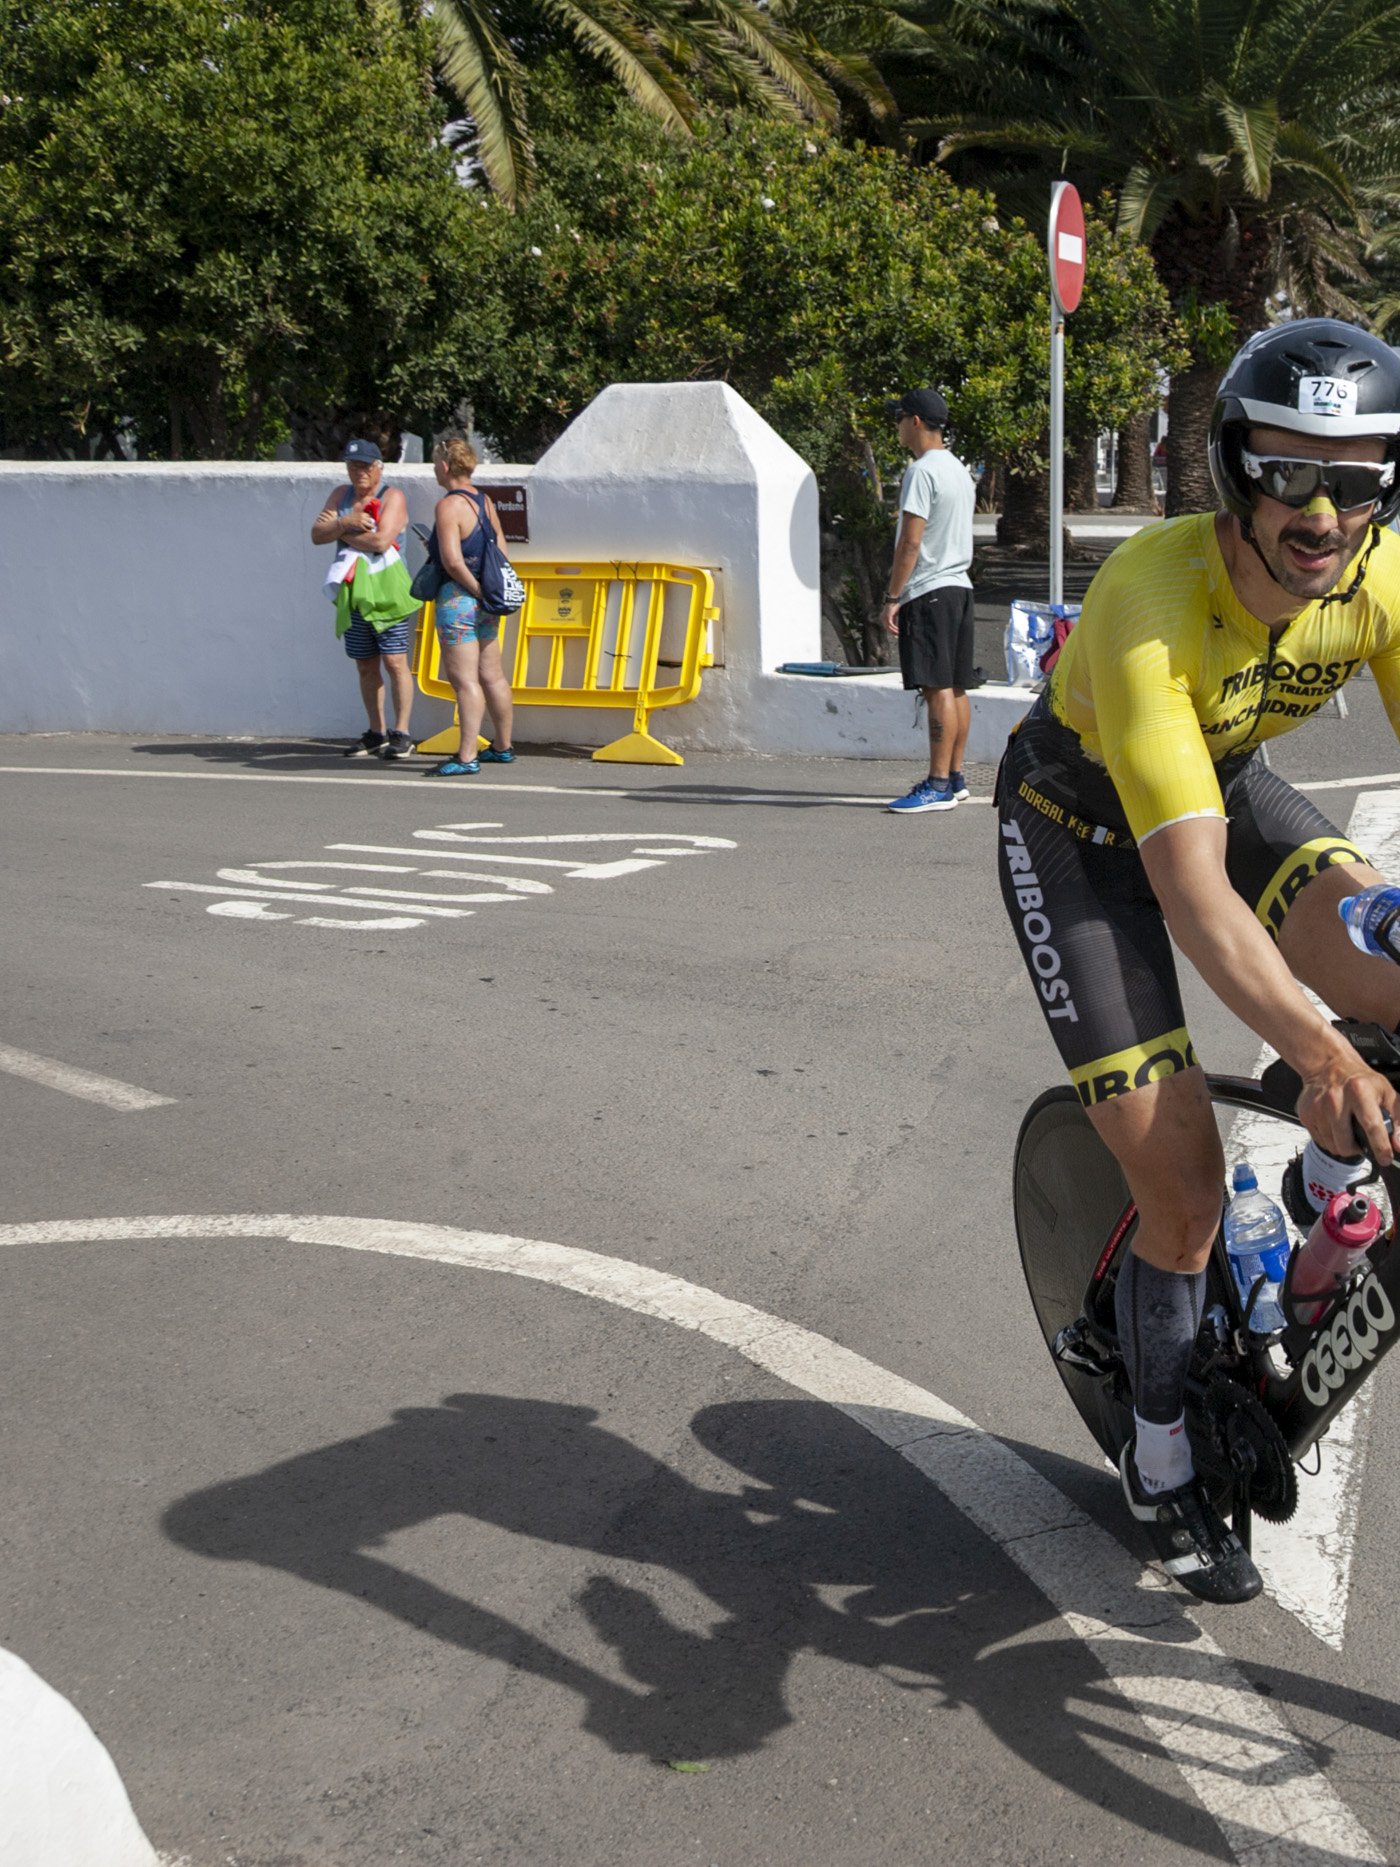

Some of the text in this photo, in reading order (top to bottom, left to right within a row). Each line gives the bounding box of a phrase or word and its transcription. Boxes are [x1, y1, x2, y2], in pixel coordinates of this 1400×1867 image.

[1311, 381, 1348, 399] 776
[1219, 657, 1361, 704] TRIBOOST
[1018, 781, 1116, 846] DORSAL KEER
[1001, 818, 1079, 1024] TRIBOOST
